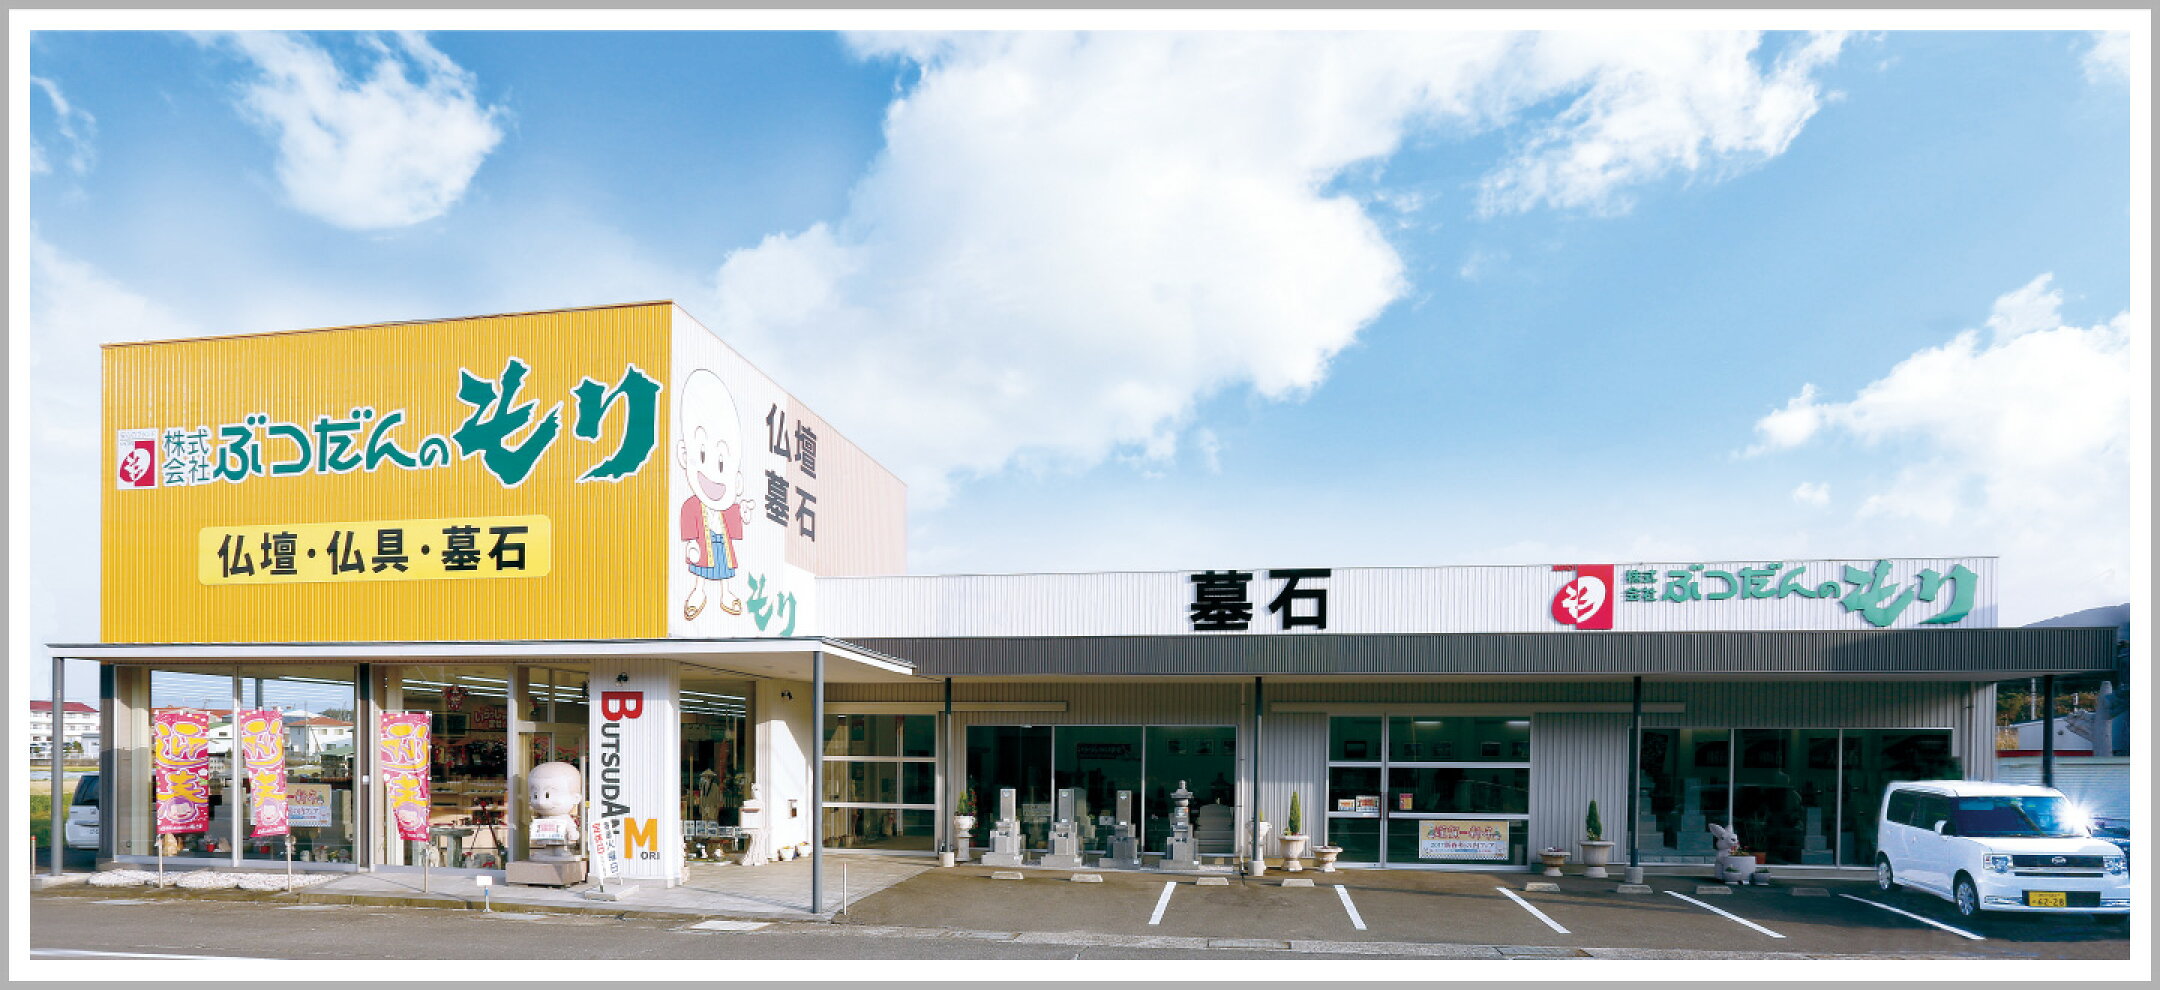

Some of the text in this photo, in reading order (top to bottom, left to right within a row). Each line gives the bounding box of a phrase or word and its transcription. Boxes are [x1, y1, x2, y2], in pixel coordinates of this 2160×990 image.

[163, 428, 208, 457] 株式
[213, 358, 661, 486] ぶつだんのもり
[765, 402, 817, 479] 仏壇
[162, 455, 210, 483] 会社
[764, 469, 817, 543] 墓石
[217, 524, 529, 578] 仏壇・仏具・墓石
[1624, 569, 1658, 584] 株式
[746, 571, 797, 637] もり
[1190, 568, 1331, 630] 墓石
[1624, 587, 1658, 601] 会社
[1662, 559, 1978, 628] ぶつだんのもり
[623, 817, 661, 860] MORI
